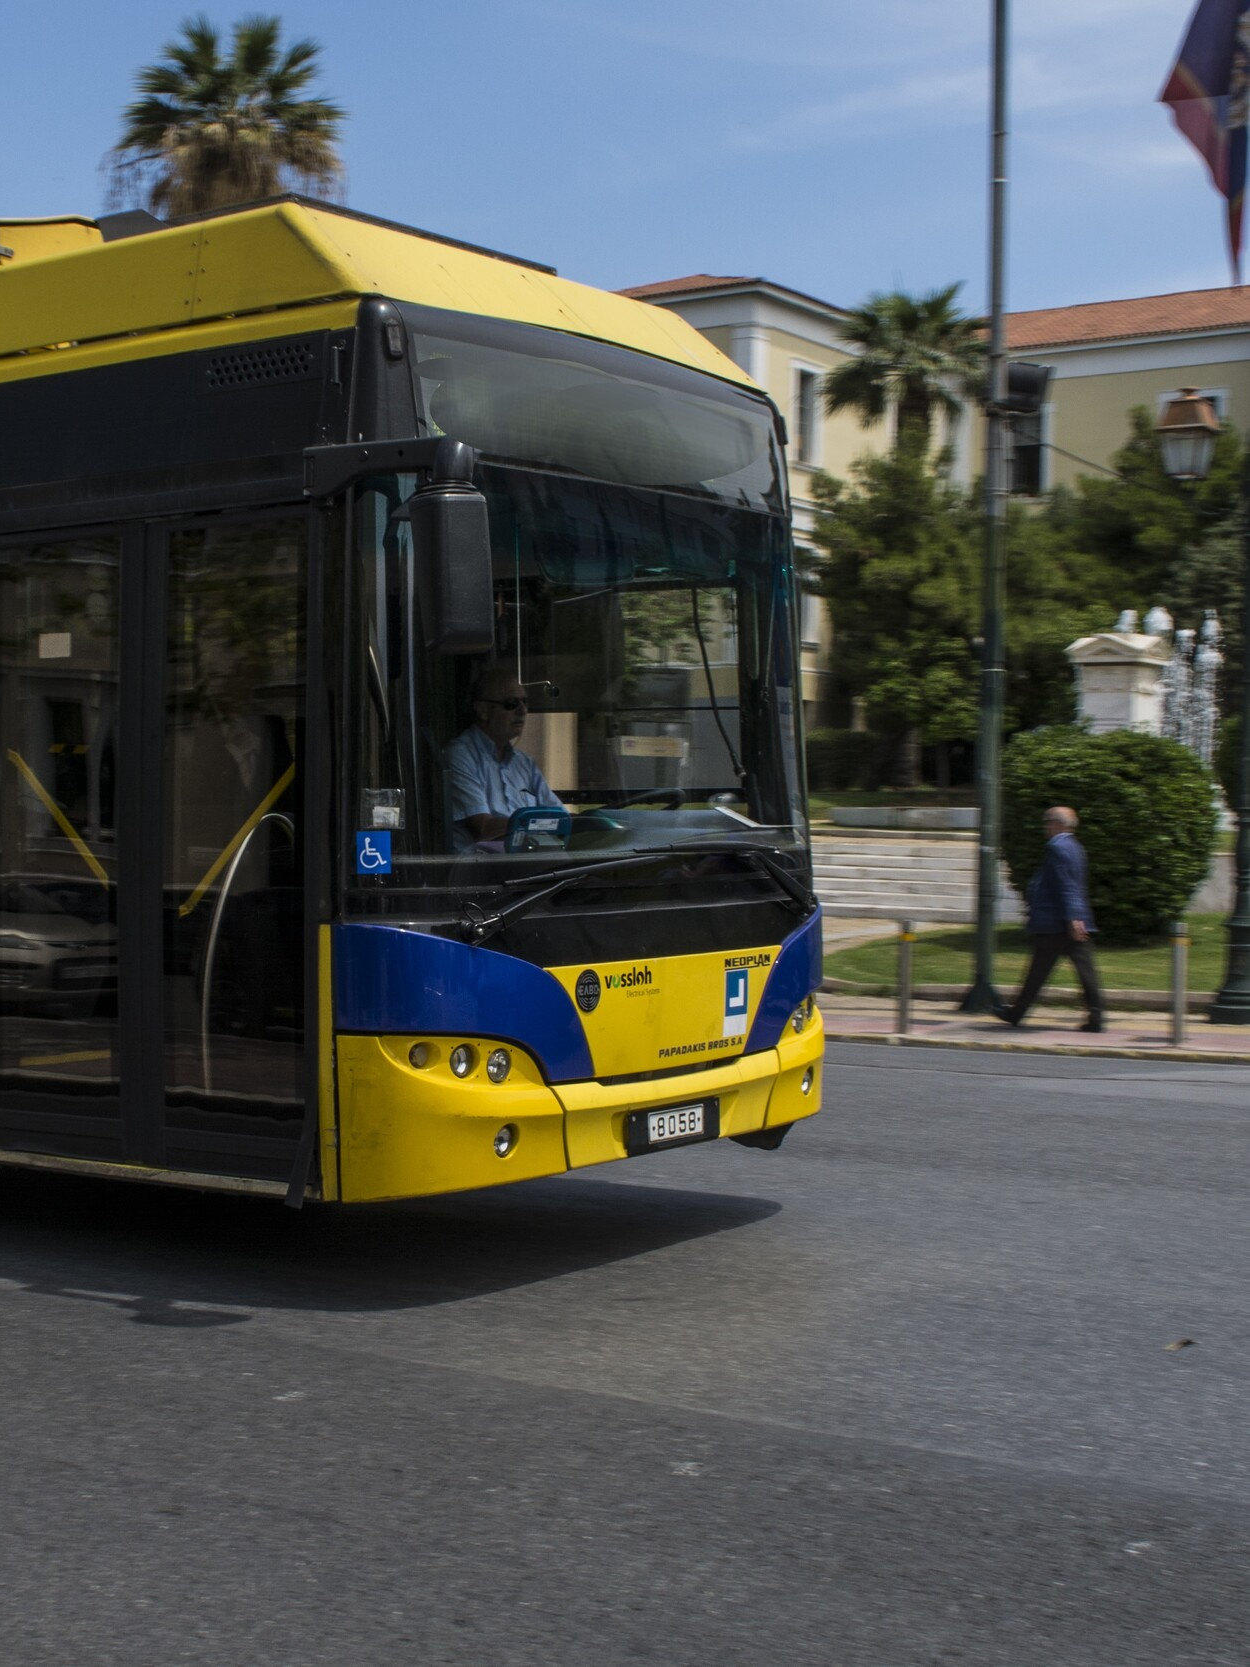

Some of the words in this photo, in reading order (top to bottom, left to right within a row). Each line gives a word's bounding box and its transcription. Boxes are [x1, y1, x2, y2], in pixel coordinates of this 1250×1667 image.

[724, 954, 771, 968] NEOPLAN
[604, 965, 652, 989] vossloh
[658, 1042, 706, 1058] PAPADAKIS
[708, 1039, 729, 1050] BROS
[657, 1111, 696, 1138] 8058
